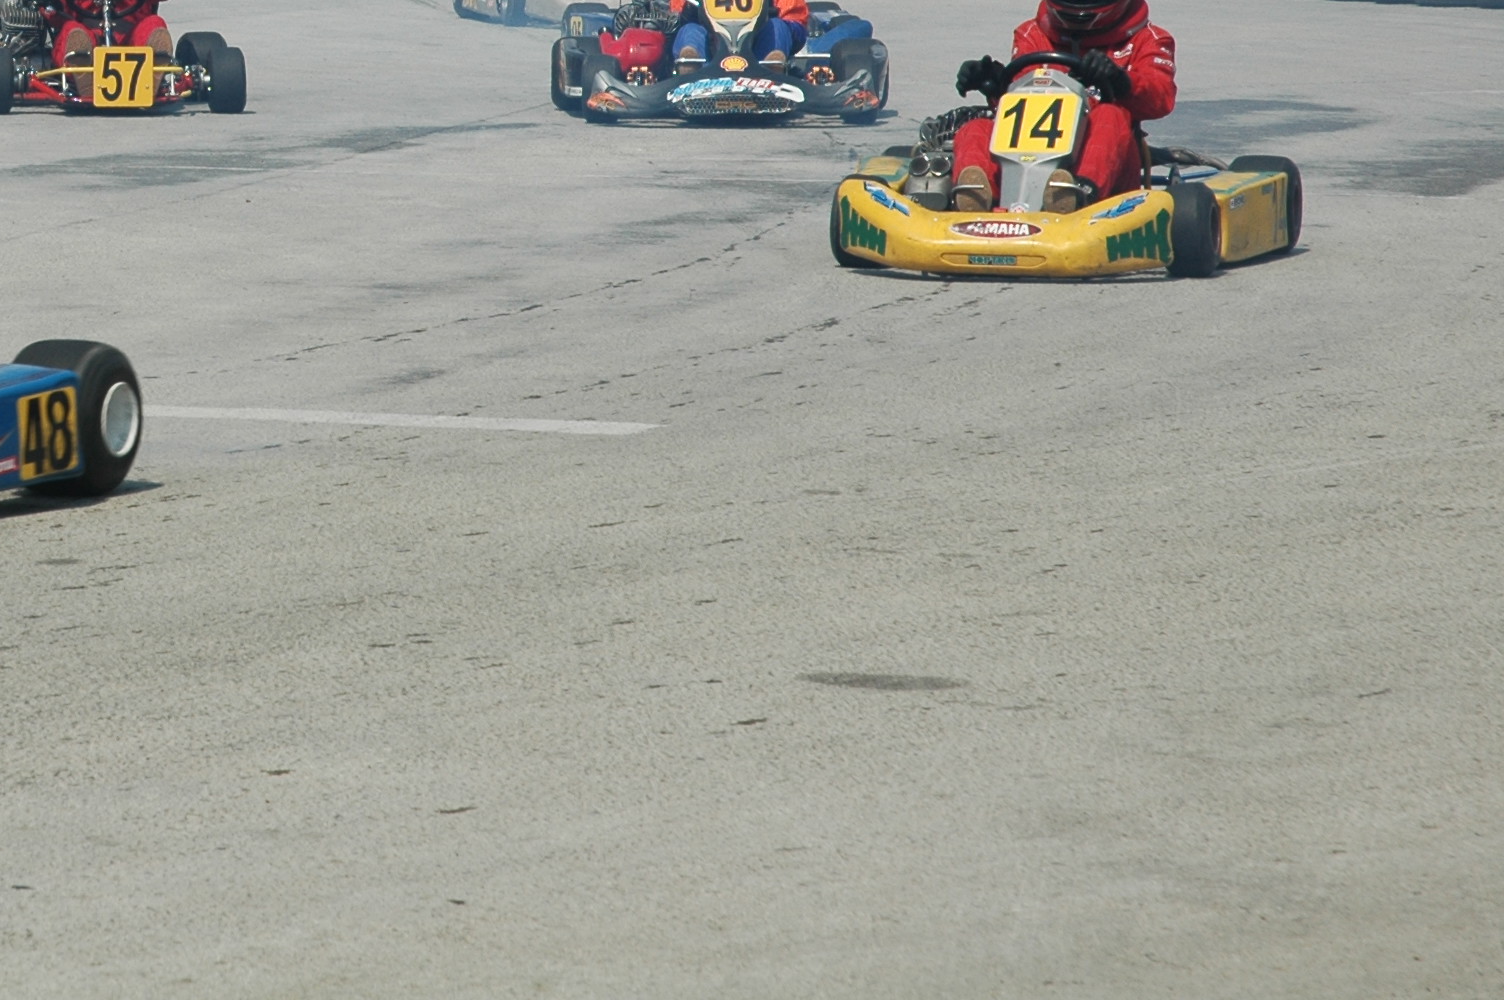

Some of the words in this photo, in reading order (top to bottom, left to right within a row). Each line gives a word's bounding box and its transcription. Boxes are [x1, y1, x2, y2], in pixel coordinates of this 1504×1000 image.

[101, 52, 147, 102] 57
[1003, 98, 1064, 149] 14
[24, 389, 72, 475] 48
